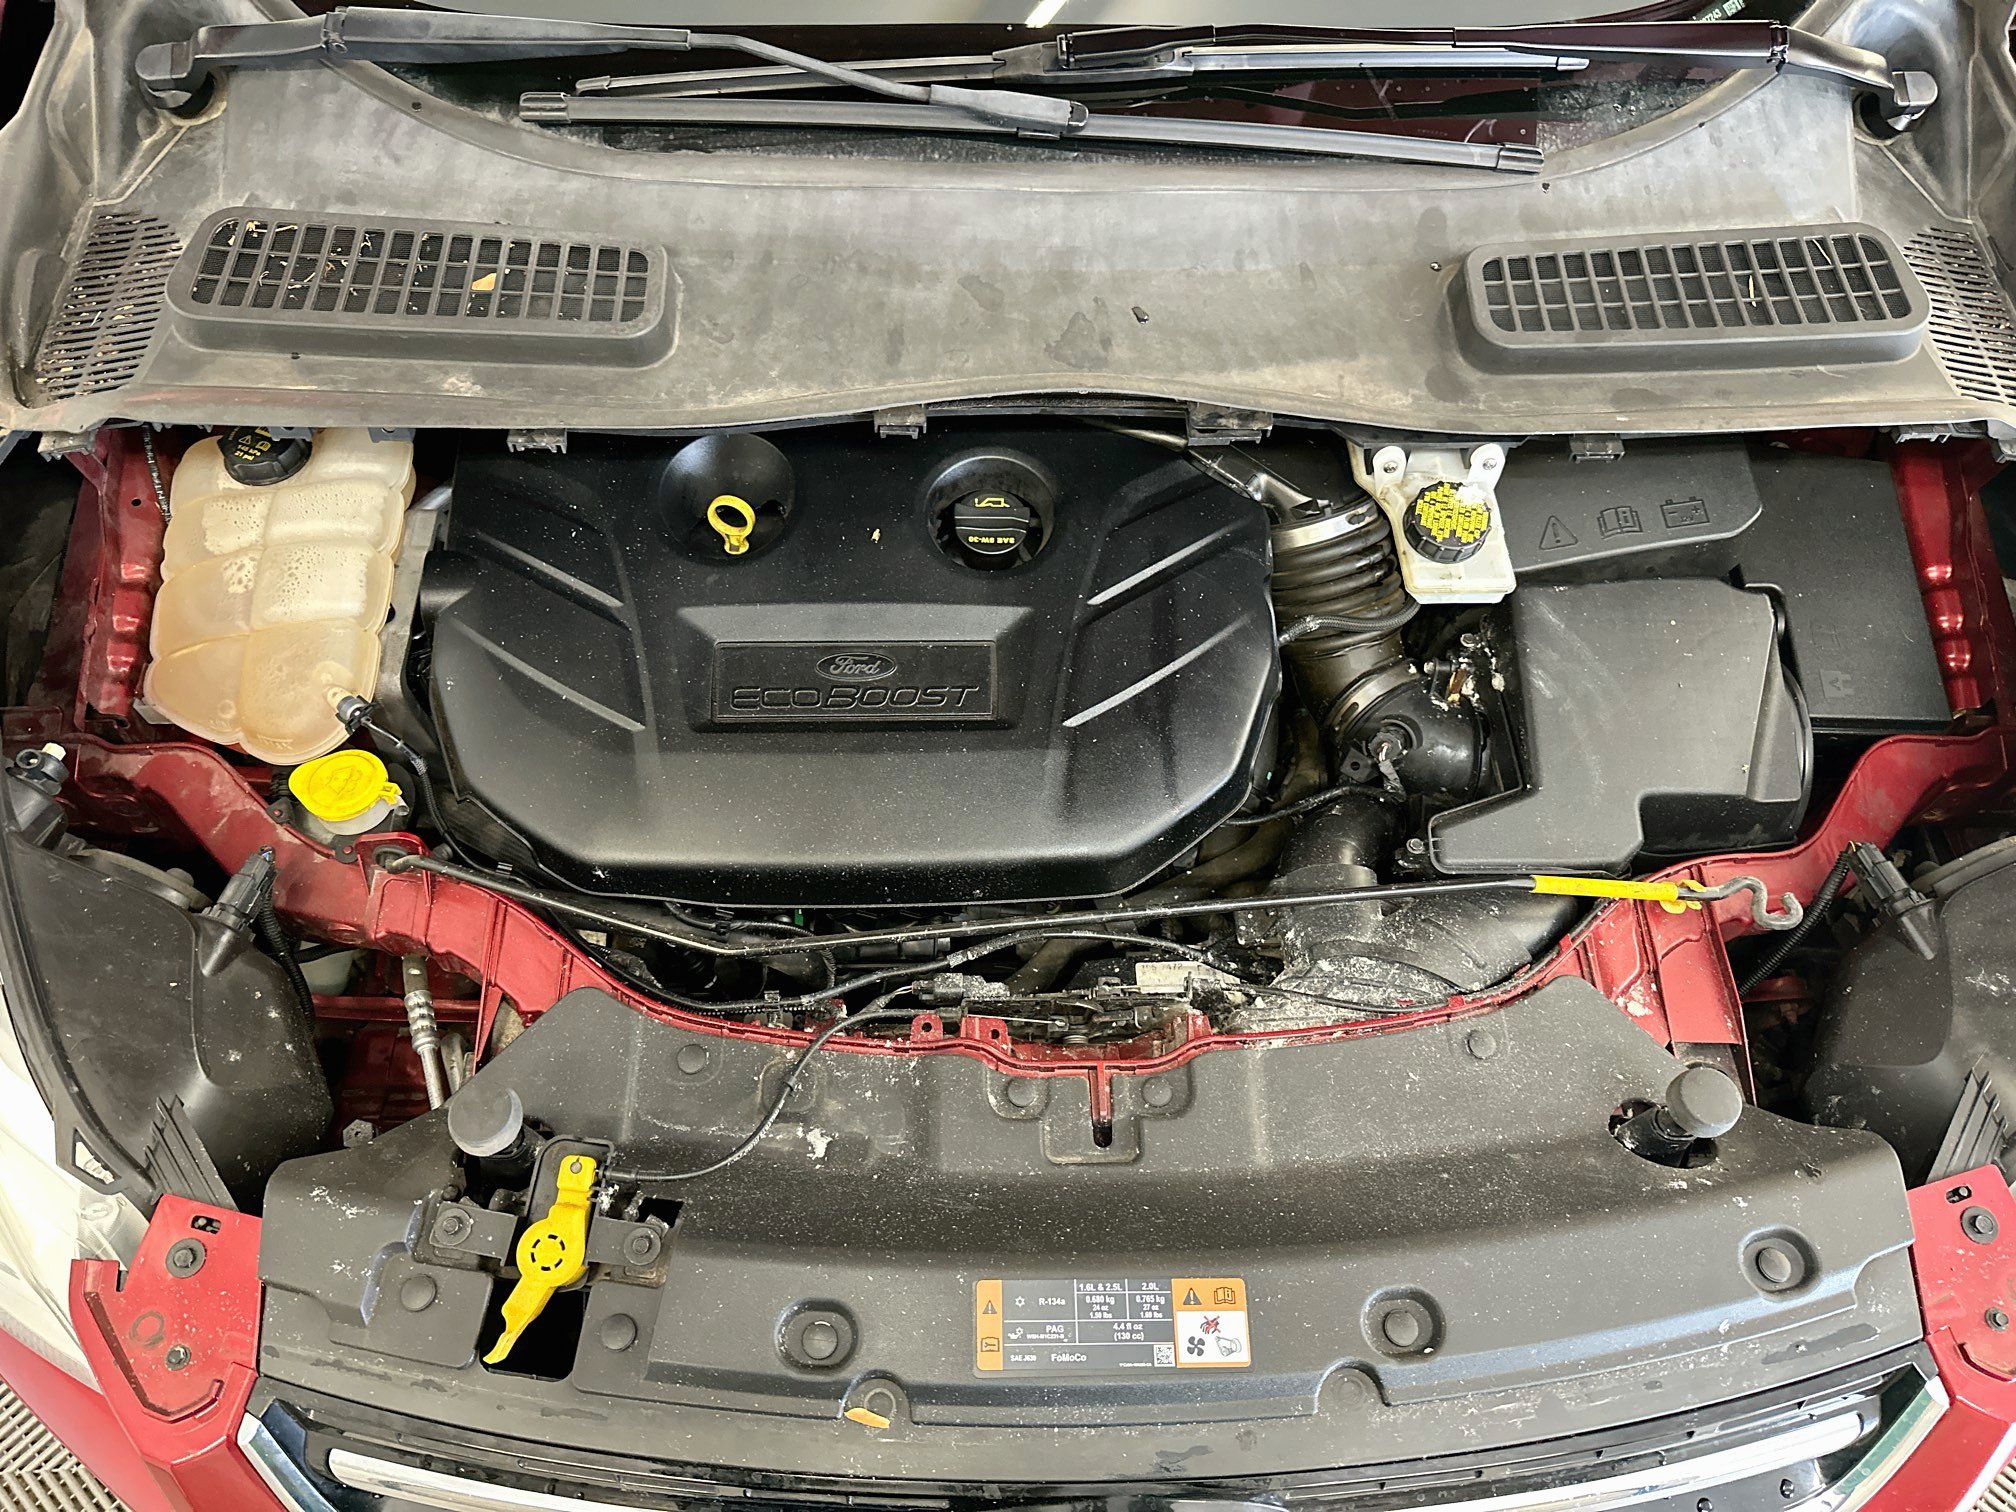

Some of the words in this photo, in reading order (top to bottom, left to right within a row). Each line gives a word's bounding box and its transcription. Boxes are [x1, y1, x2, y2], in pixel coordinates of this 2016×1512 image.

[829, 655, 881, 676] Ford
[1079, 1283, 1096, 1291] 1.6L
[1098, 1283, 1104, 1291] &
[1105, 1283, 1123, 1291] 2.5L
[1141, 1282, 1159, 1291] 2.0L
[1038, 1297, 1066, 1306] R-134a
[1085, 1295, 1105, 1303] 0.680
[1105, 1295, 1115, 1305] kg
[1135, 1295, 1155, 1303] 0.765
[1155, 1295, 1165, 1305] kg
[1142, 1303, 1151, 1311] 27
[1045, 1324, 1065, 1333] PAG
[1113, 1332, 1131, 1341] (130
[1131, 1332, 1145, 1341] cc)
[1051, 1353, 1087, 1362] FoMoCo
